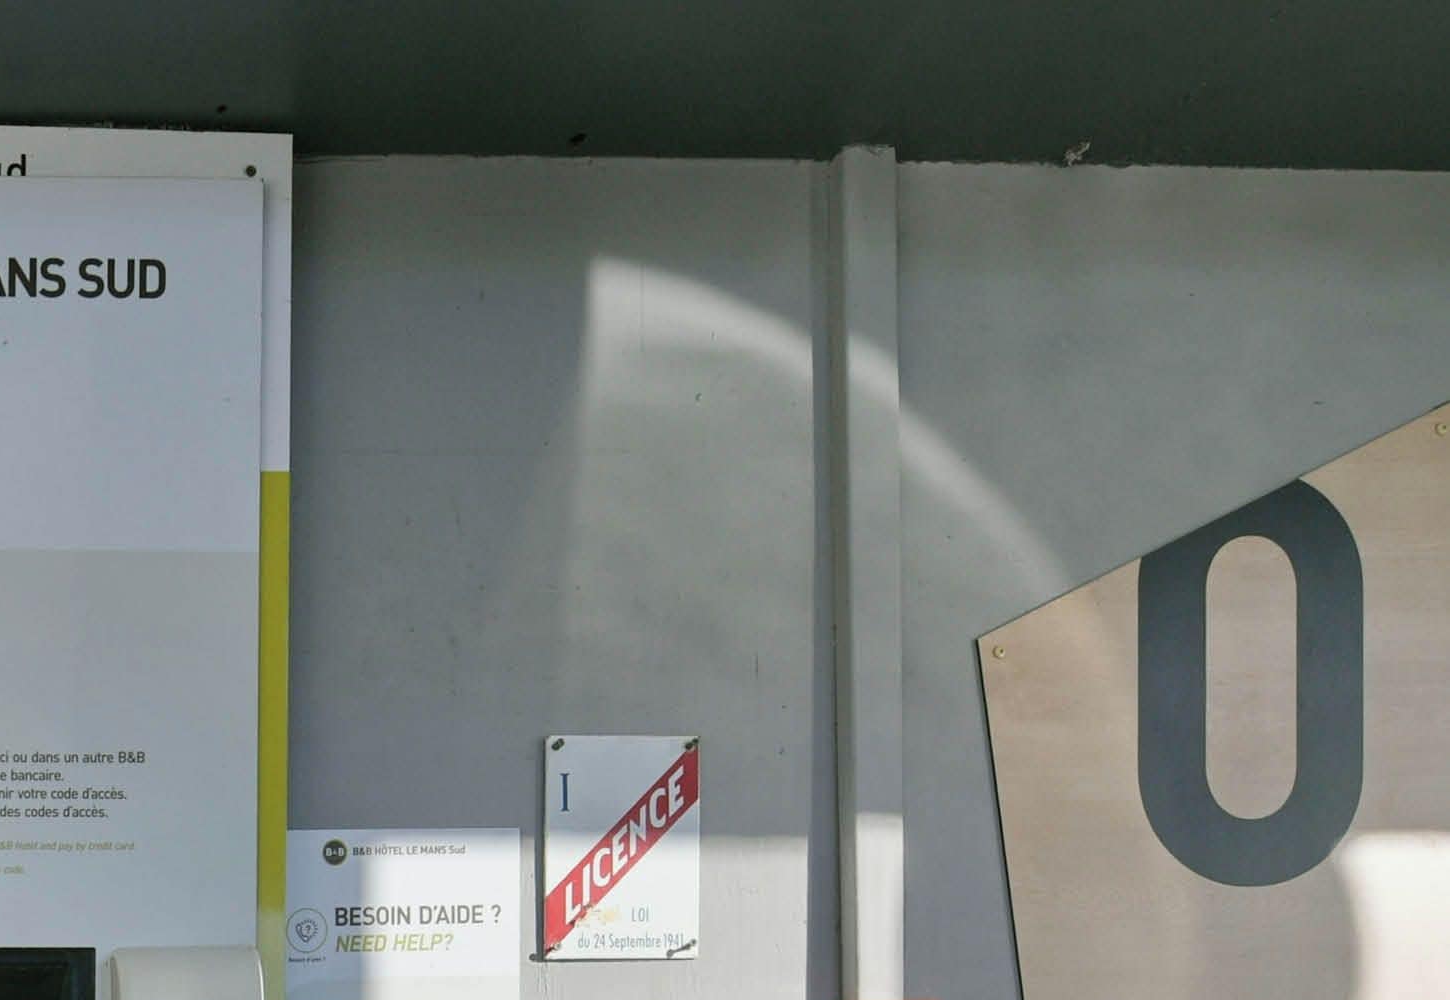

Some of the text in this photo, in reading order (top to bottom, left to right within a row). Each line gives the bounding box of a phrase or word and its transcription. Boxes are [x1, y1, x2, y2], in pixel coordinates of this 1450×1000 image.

[78, 258, 166, 299] SUD
[10, 767, 64, 785] bancaire.
[560, 773, 570, 812] I
[353, 844, 466, 856] B&B HÔTEL LE MANS Sud
[565, 764, 685, 926] LICENCE
[335, 904, 501, 926] BESOIN D'AIDE ?
[336, 934, 454, 952] NEED HELP?
[578, 933, 685, 950] du 24 Septembre 1941
